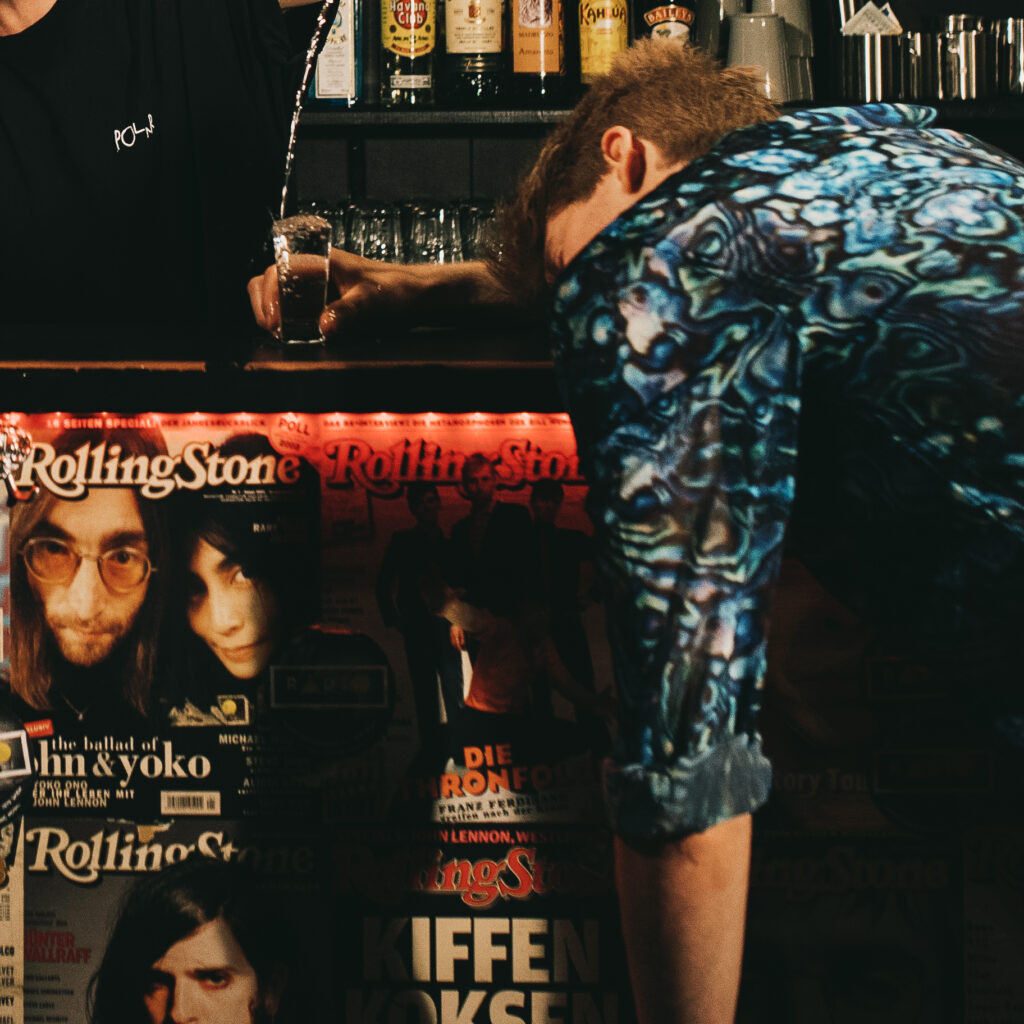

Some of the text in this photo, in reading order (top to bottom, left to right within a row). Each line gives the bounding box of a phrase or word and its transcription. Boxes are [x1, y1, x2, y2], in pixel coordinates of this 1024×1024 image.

[15, 439, 301, 500] Rolling Stone
[51, 735, 159, 752] the ballad of
[91, 751, 116, 778] &
[117, 740, 212, 789] yoko
[463, 743, 513, 770] DIE
[65, 779, 89, 791] ONO
[115, 788, 136, 799] MIT
[64, 796, 108, 808] LENNON
[363, 915, 600, 984] KIFFEN
